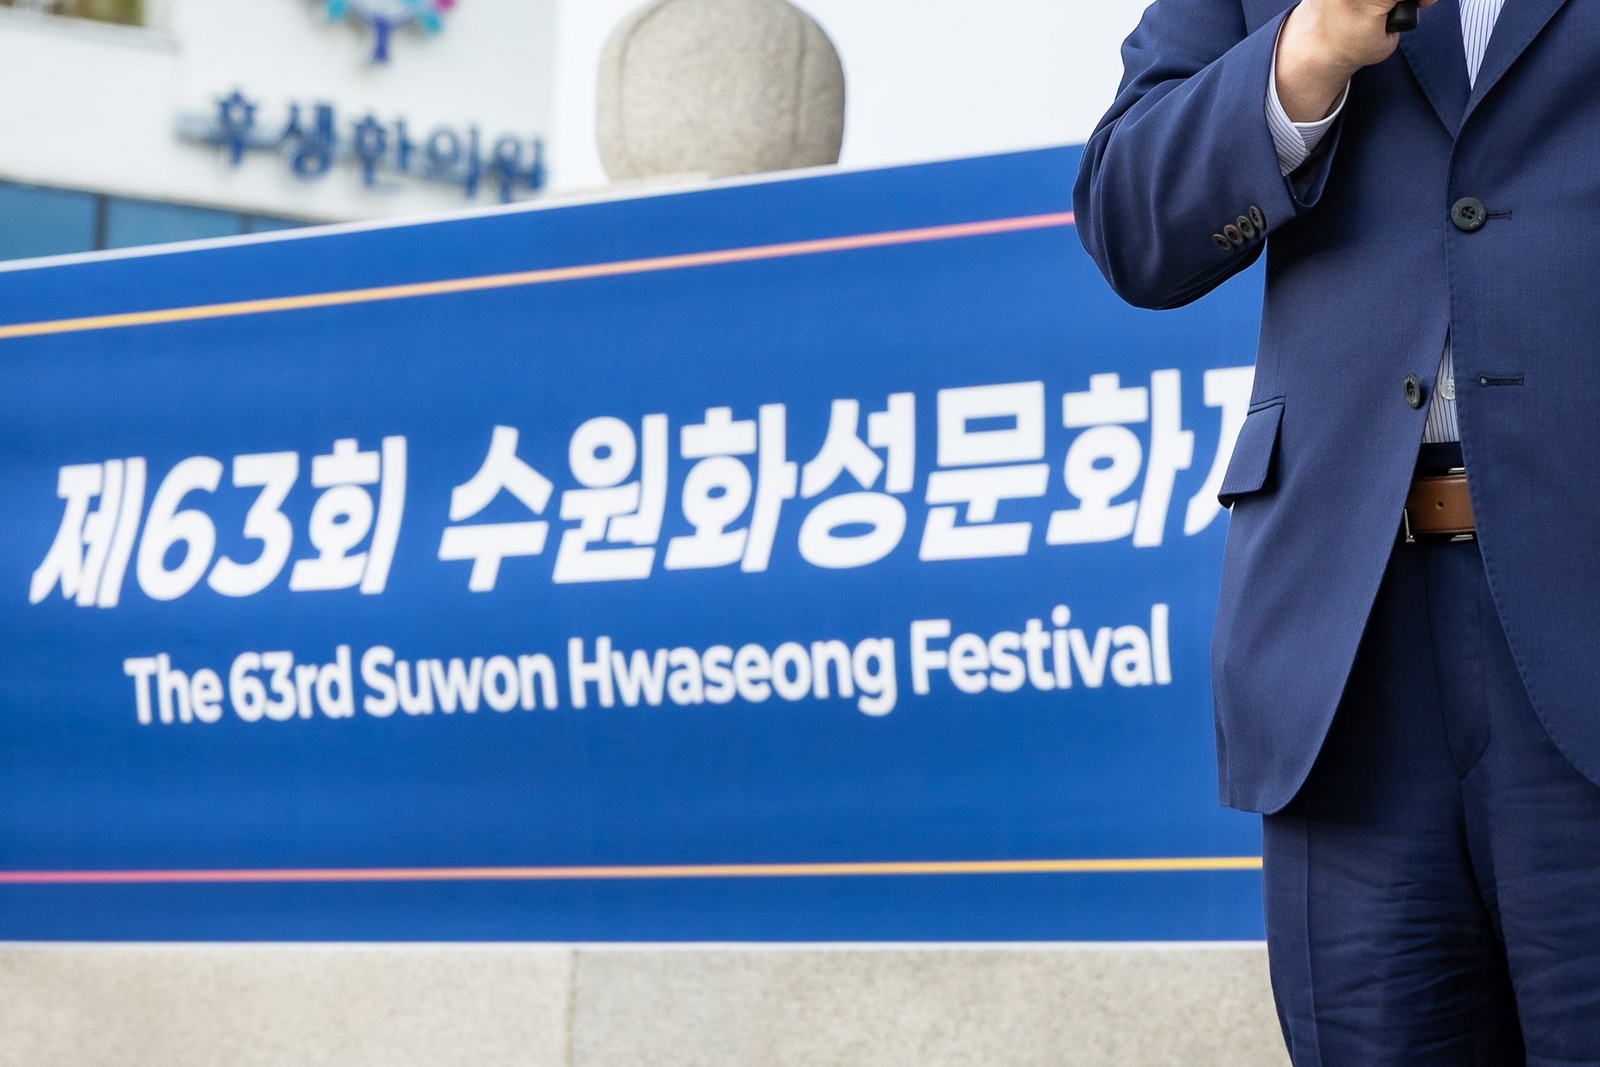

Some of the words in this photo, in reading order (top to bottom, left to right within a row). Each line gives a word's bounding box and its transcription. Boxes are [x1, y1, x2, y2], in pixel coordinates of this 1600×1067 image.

[28, 435, 407, 609] 제63회
[123, 652, 224, 724] The
[229, 644, 355, 722] 63rd
[360, 645, 558, 717] Suwon
[568, 635, 898, 717] Hwaseong
[910, 603, 1172, 695] Festival
